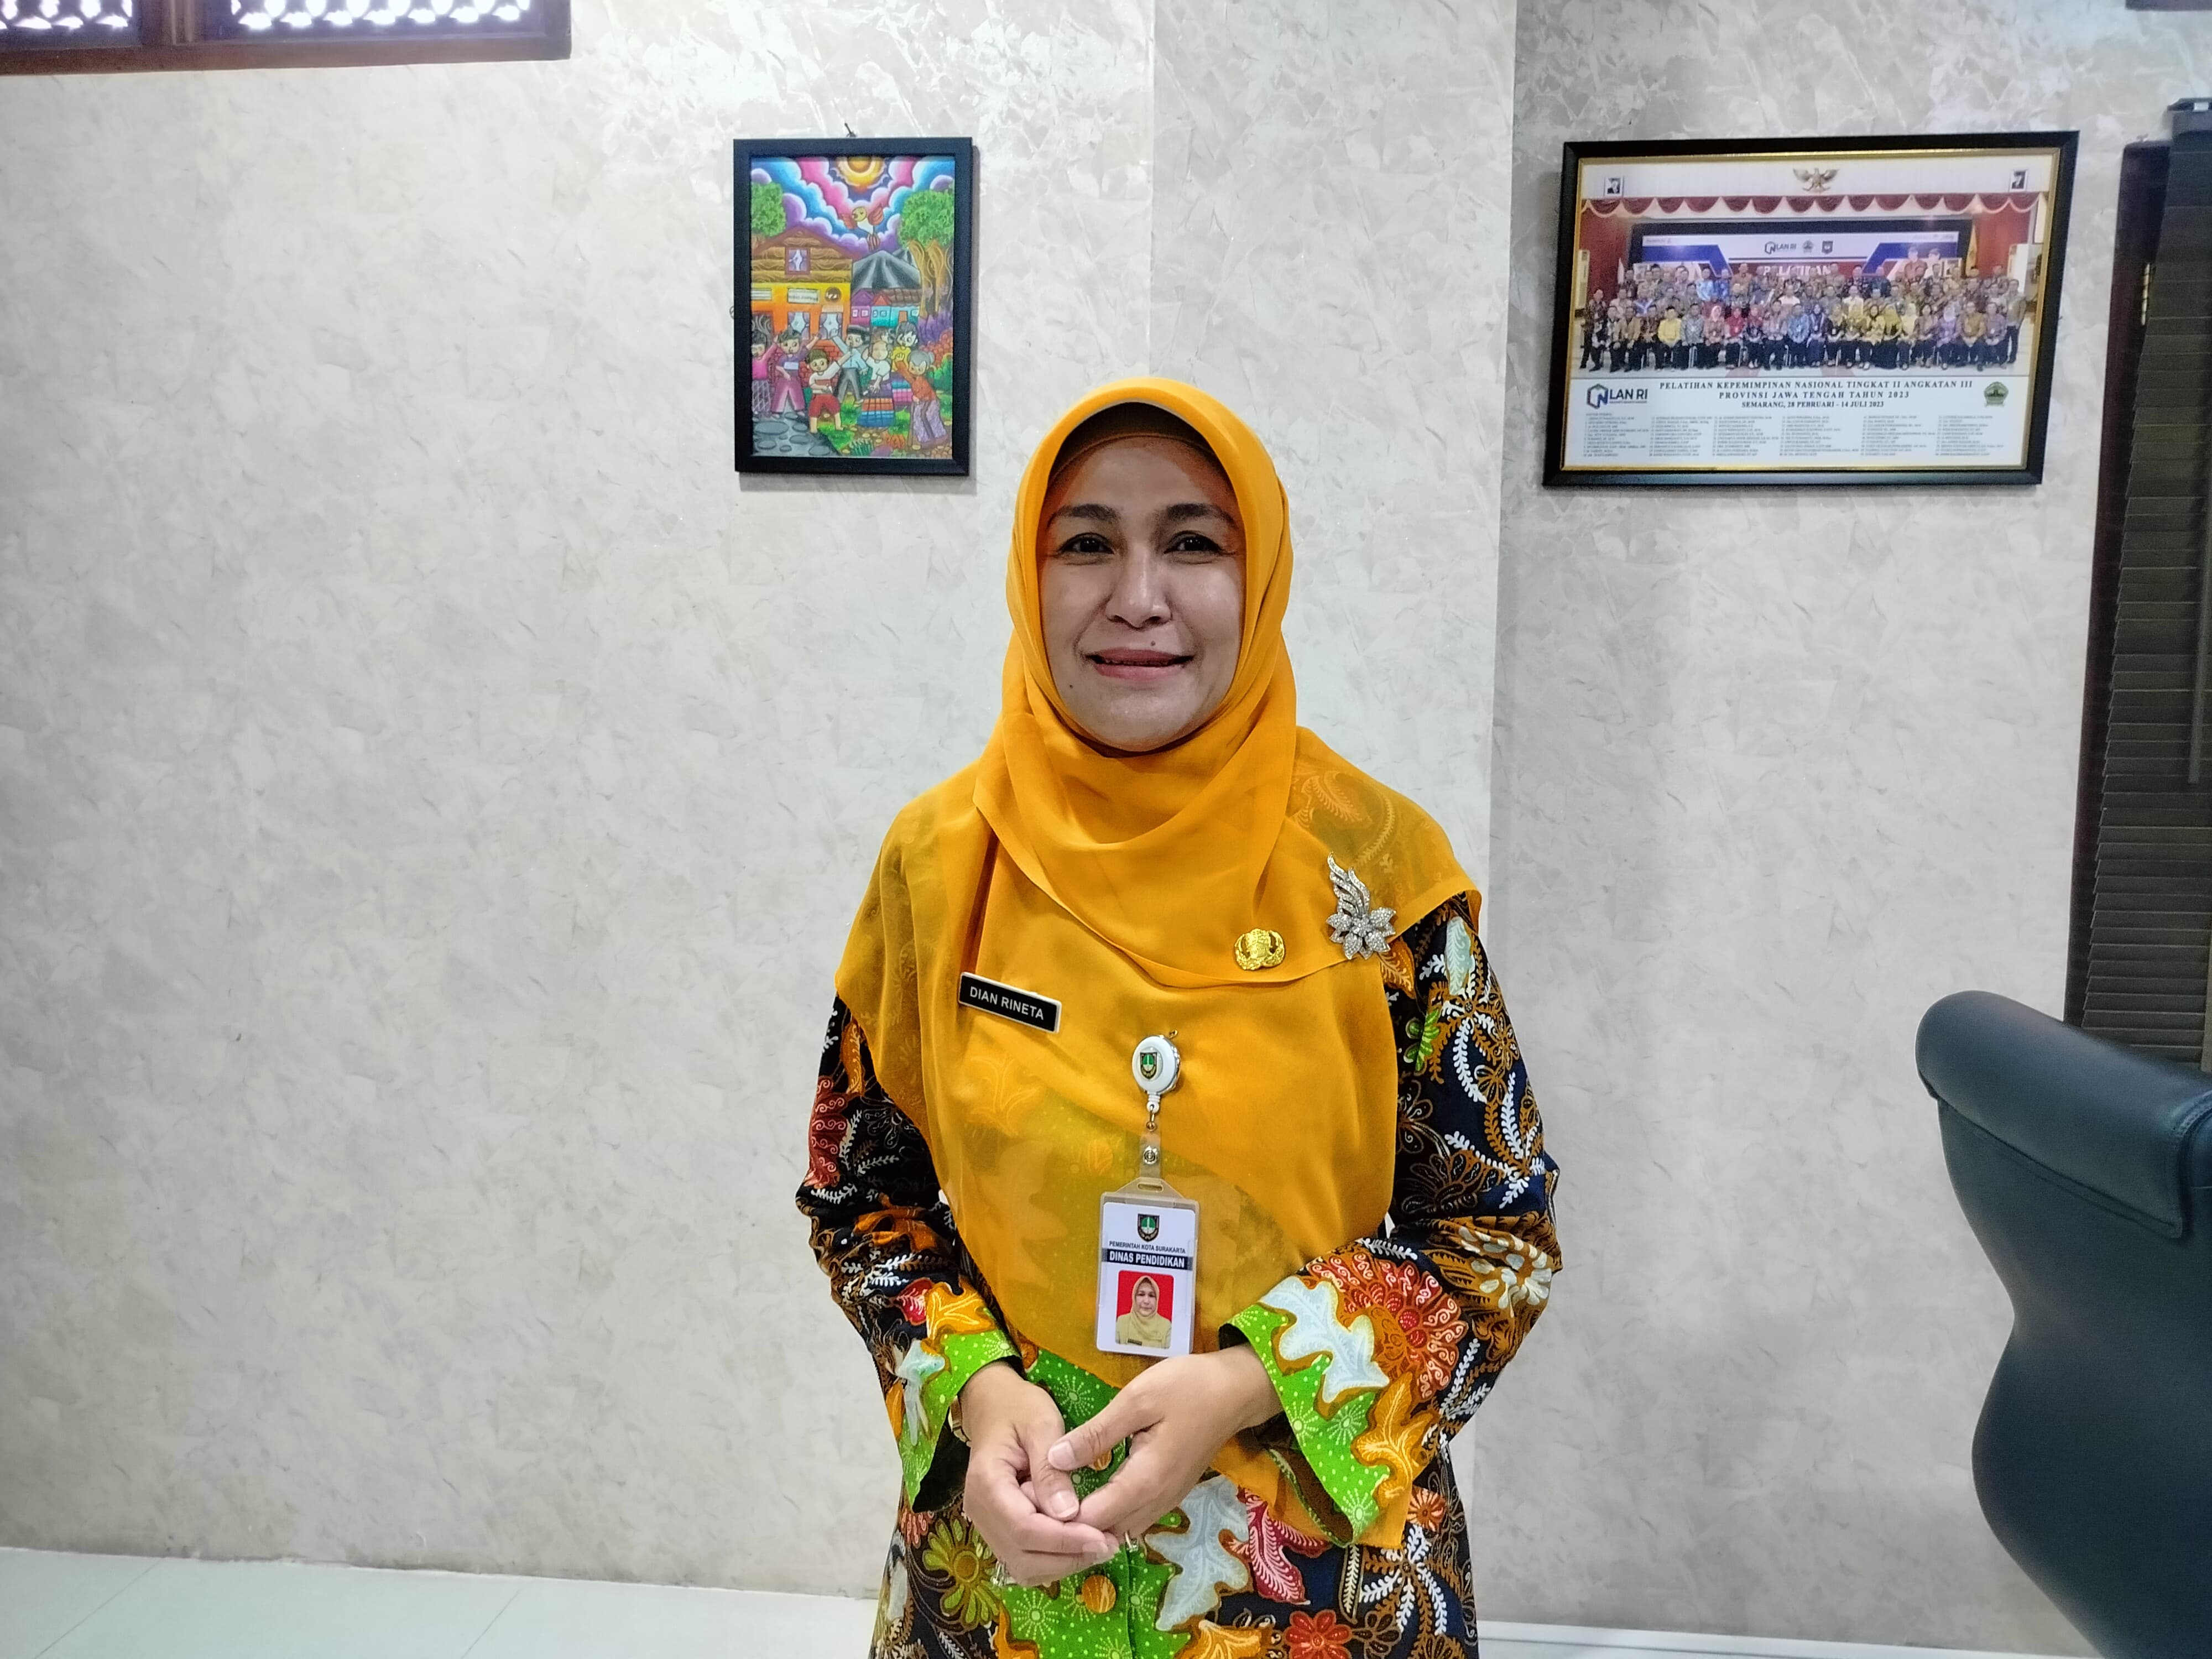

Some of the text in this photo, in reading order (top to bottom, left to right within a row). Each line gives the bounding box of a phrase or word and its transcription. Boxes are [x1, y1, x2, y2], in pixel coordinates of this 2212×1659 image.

[1659, 382, 1713, 390] PELATIHAN
[1717, 381, 1792, 389] KEPEMIMPINAN
[1794, 380, 1843, 389] NASIONAL
[1846, 380, 1890, 388] TINGKAT
[1903, 380, 1957, 388] ANGKATAN
[1960, 380, 1973, 388] III
[1610, 388, 1648, 400] LAN RI
[970, 986, 1044, 1021] DIAN RINETA
[1109, 1240, 1141, 1250] PEMERINTAH
[1156, 1245, 1186, 1254] SURAKARTA
[1109, 1250, 1185, 1268] DINAS PENDIDIKAN
